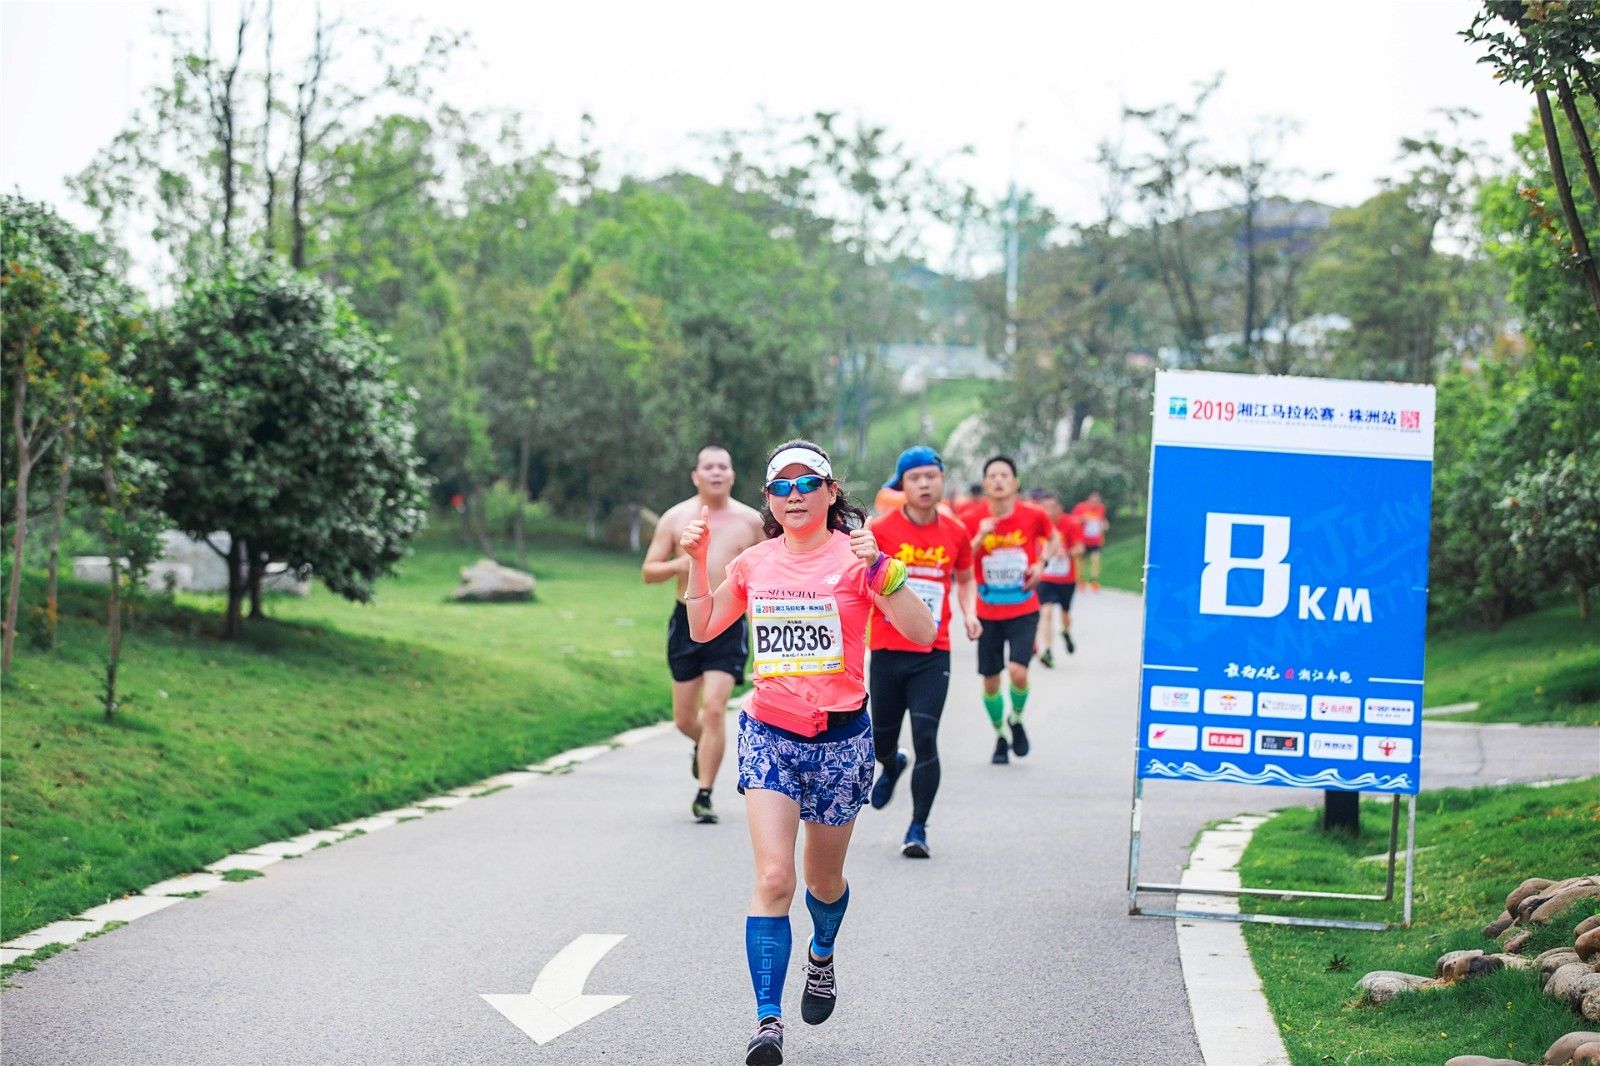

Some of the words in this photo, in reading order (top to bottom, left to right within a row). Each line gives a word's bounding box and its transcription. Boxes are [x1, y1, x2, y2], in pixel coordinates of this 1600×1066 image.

[768, 590, 816, 599] SHANGHAI
[1298, 584, 1373, 624] KM
[756, 625, 832, 653] B20336
[757, 936, 779, 1000] kalenji
